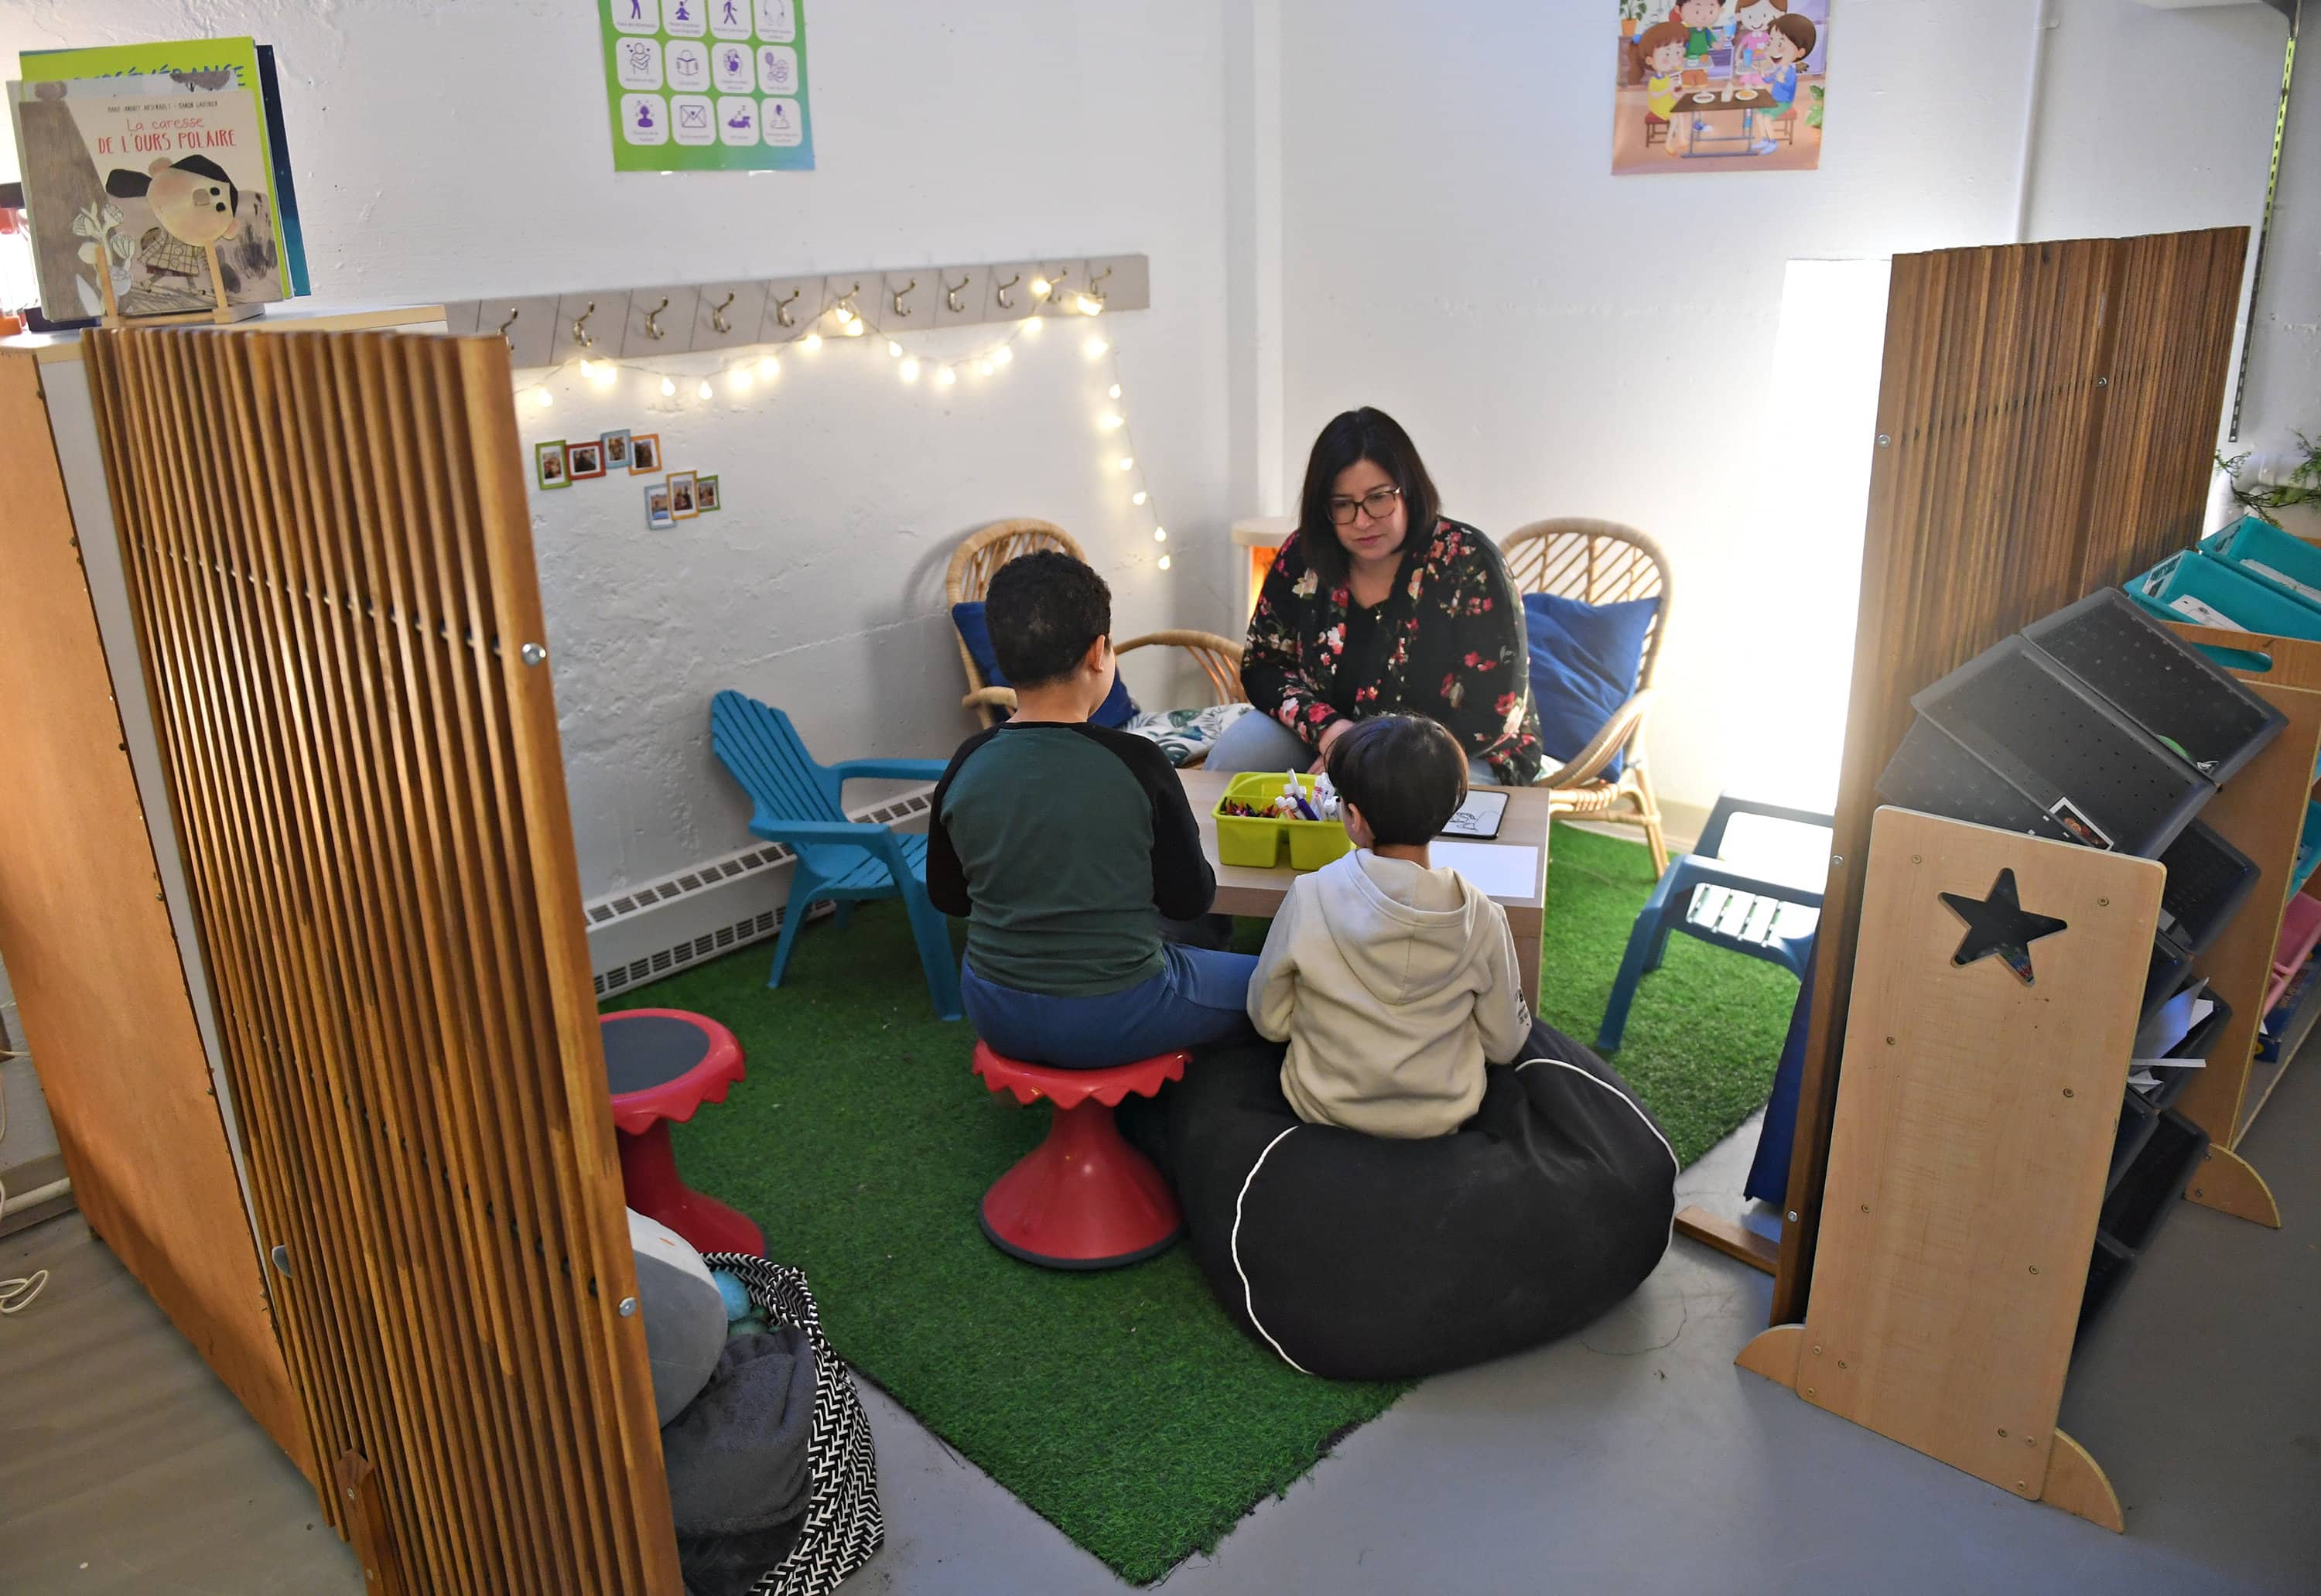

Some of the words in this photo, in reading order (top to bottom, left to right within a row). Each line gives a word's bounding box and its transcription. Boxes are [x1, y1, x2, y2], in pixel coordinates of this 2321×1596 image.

[127, 118, 144, 132] La
[152, 118, 204, 130] caresse
[98, 136, 115, 154] DE
[121, 132, 171, 153] L'OURS
[178, 129, 236, 149] POLAIRE
